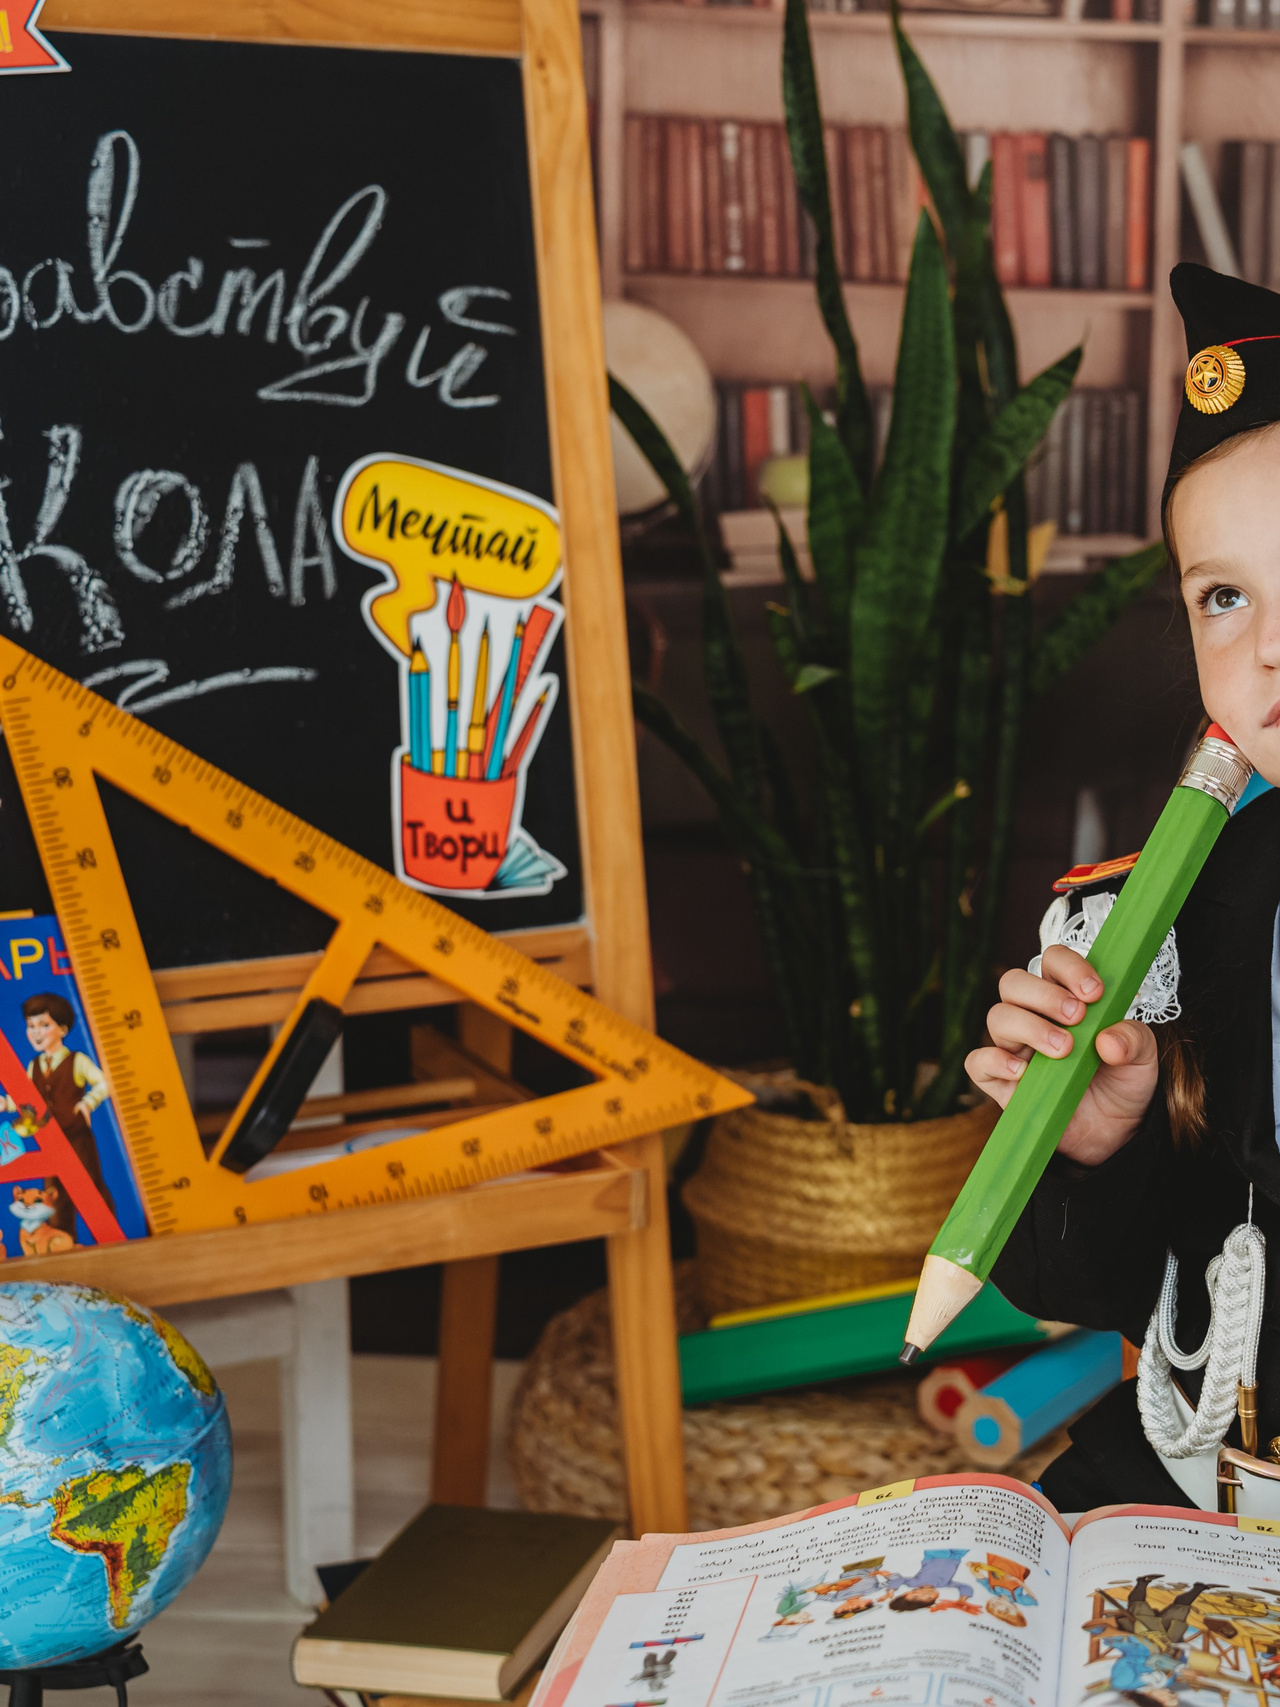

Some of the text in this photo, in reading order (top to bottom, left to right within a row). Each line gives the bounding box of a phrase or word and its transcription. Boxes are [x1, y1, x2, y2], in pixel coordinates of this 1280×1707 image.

[358, 484, 539, 572] Мечтай
[78, 720, 94, 738] 5
[446, 799, 474, 824] и
[406, 822, 507, 874] Твори
[875, 1491, 893, 1500] 79
[1256, 1525, 1274, 1533] 78
[688, 1571, 723, 1582] руки
